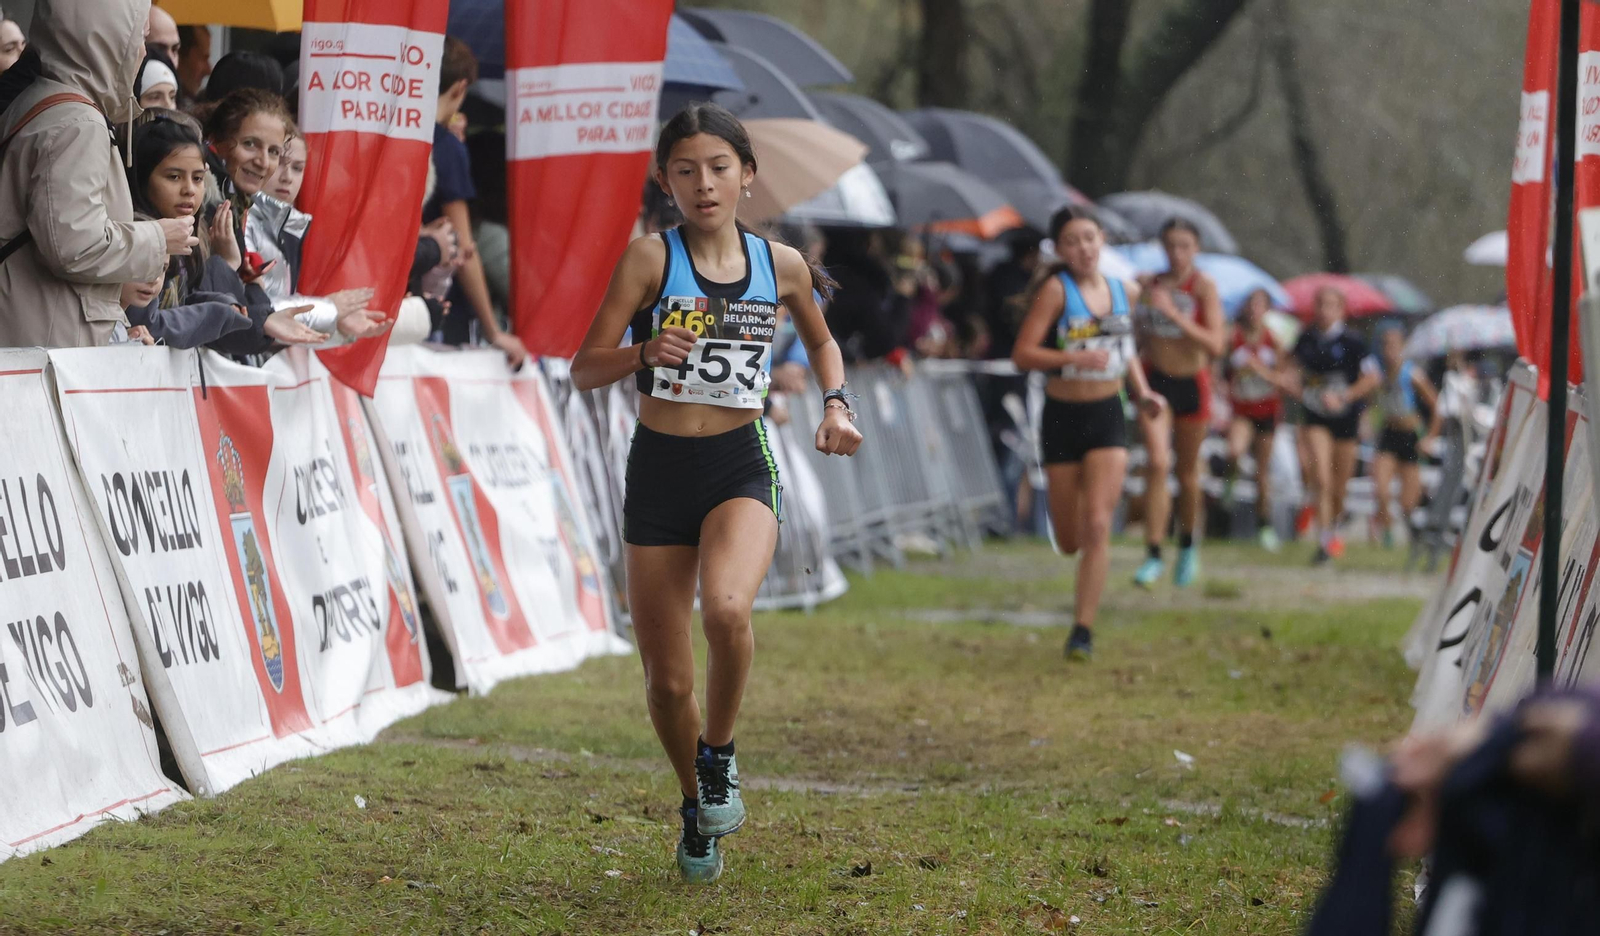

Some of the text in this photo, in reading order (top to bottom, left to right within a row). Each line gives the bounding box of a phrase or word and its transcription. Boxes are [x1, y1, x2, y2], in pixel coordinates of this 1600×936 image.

[308, 71, 325, 91] A
[341, 99, 387, 123] PARA
[519, 108, 533, 124] A
[577, 125, 619, 144] PARA
[729, 303, 776, 315] MEMORIAL
[723, 314, 776, 326] BELARMNO
[739, 326, 773, 337] ALONSO
[167, 579, 221, 666] VIGO
[7, 610, 94, 714] VIGO
